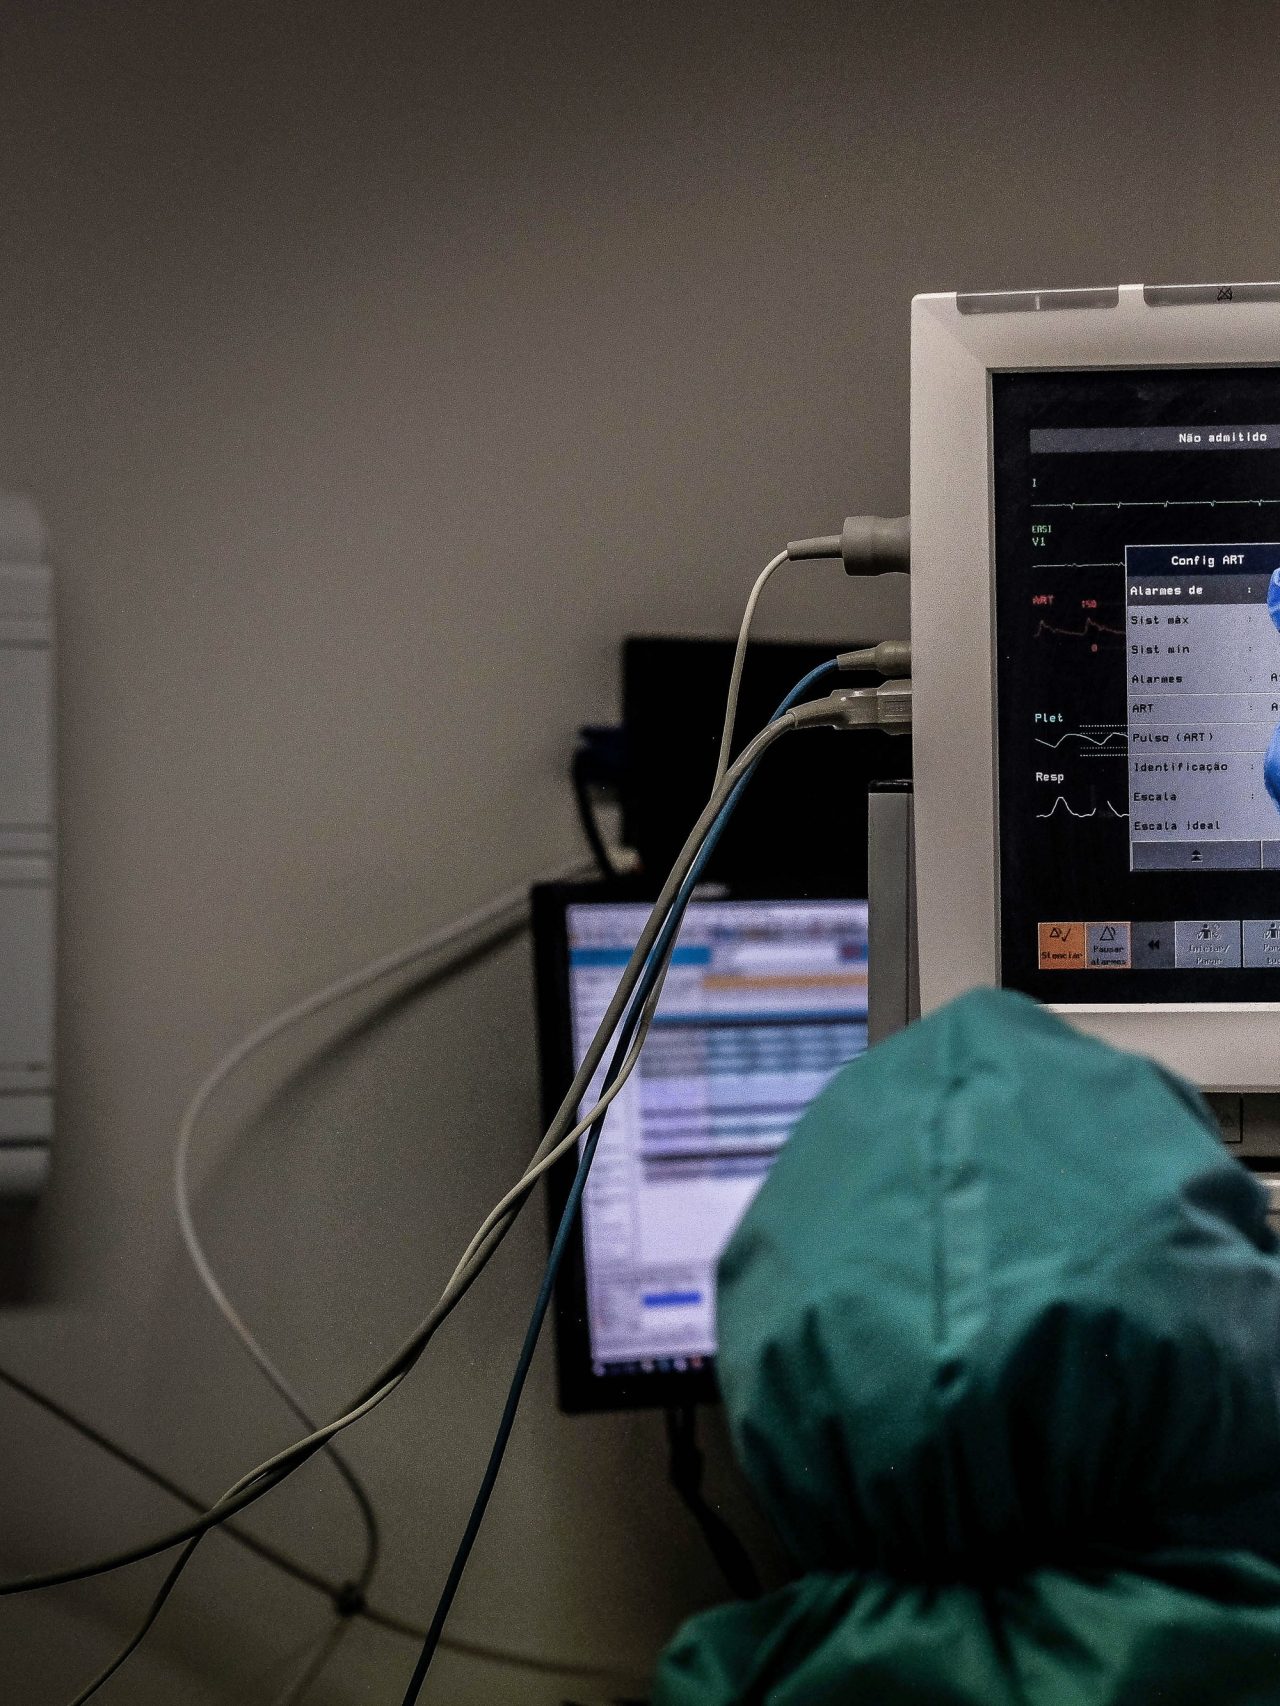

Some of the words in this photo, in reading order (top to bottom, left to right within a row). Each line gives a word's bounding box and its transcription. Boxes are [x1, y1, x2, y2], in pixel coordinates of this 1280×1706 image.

[1179, 430, 1201, 443] Não
[1208, 429, 1267, 443] admitido
[1031, 537, 1046, 547] V1
[1171, 555, 1215, 568] Config
[1223, 554, 1245, 565] ART
[1130, 586, 1182, 596] Alarmes
[1188, 585, 1204, 595] de
[1131, 616, 1159, 625] Sist
[1167, 615, 1189, 625] máx
[1131, 645, 1160, 655] Sist
[1131, 674, 1183, 684] Alarmes
[1132, 703, 1154, 713] ART
[1035, 713, 1063, 723] Plet
[1132, 733, 1169, 742] Pulso
[1176, 732, 1213, 742] (ART)
[1134, 762, 1228, 774] Identificação
[1036, 772, 1064, 783] Resp
[1133, 791, 1177, 802] Escala
[1134, 821, 1178, 831] Escala
[1187, 820, 1221, 831] ideal
